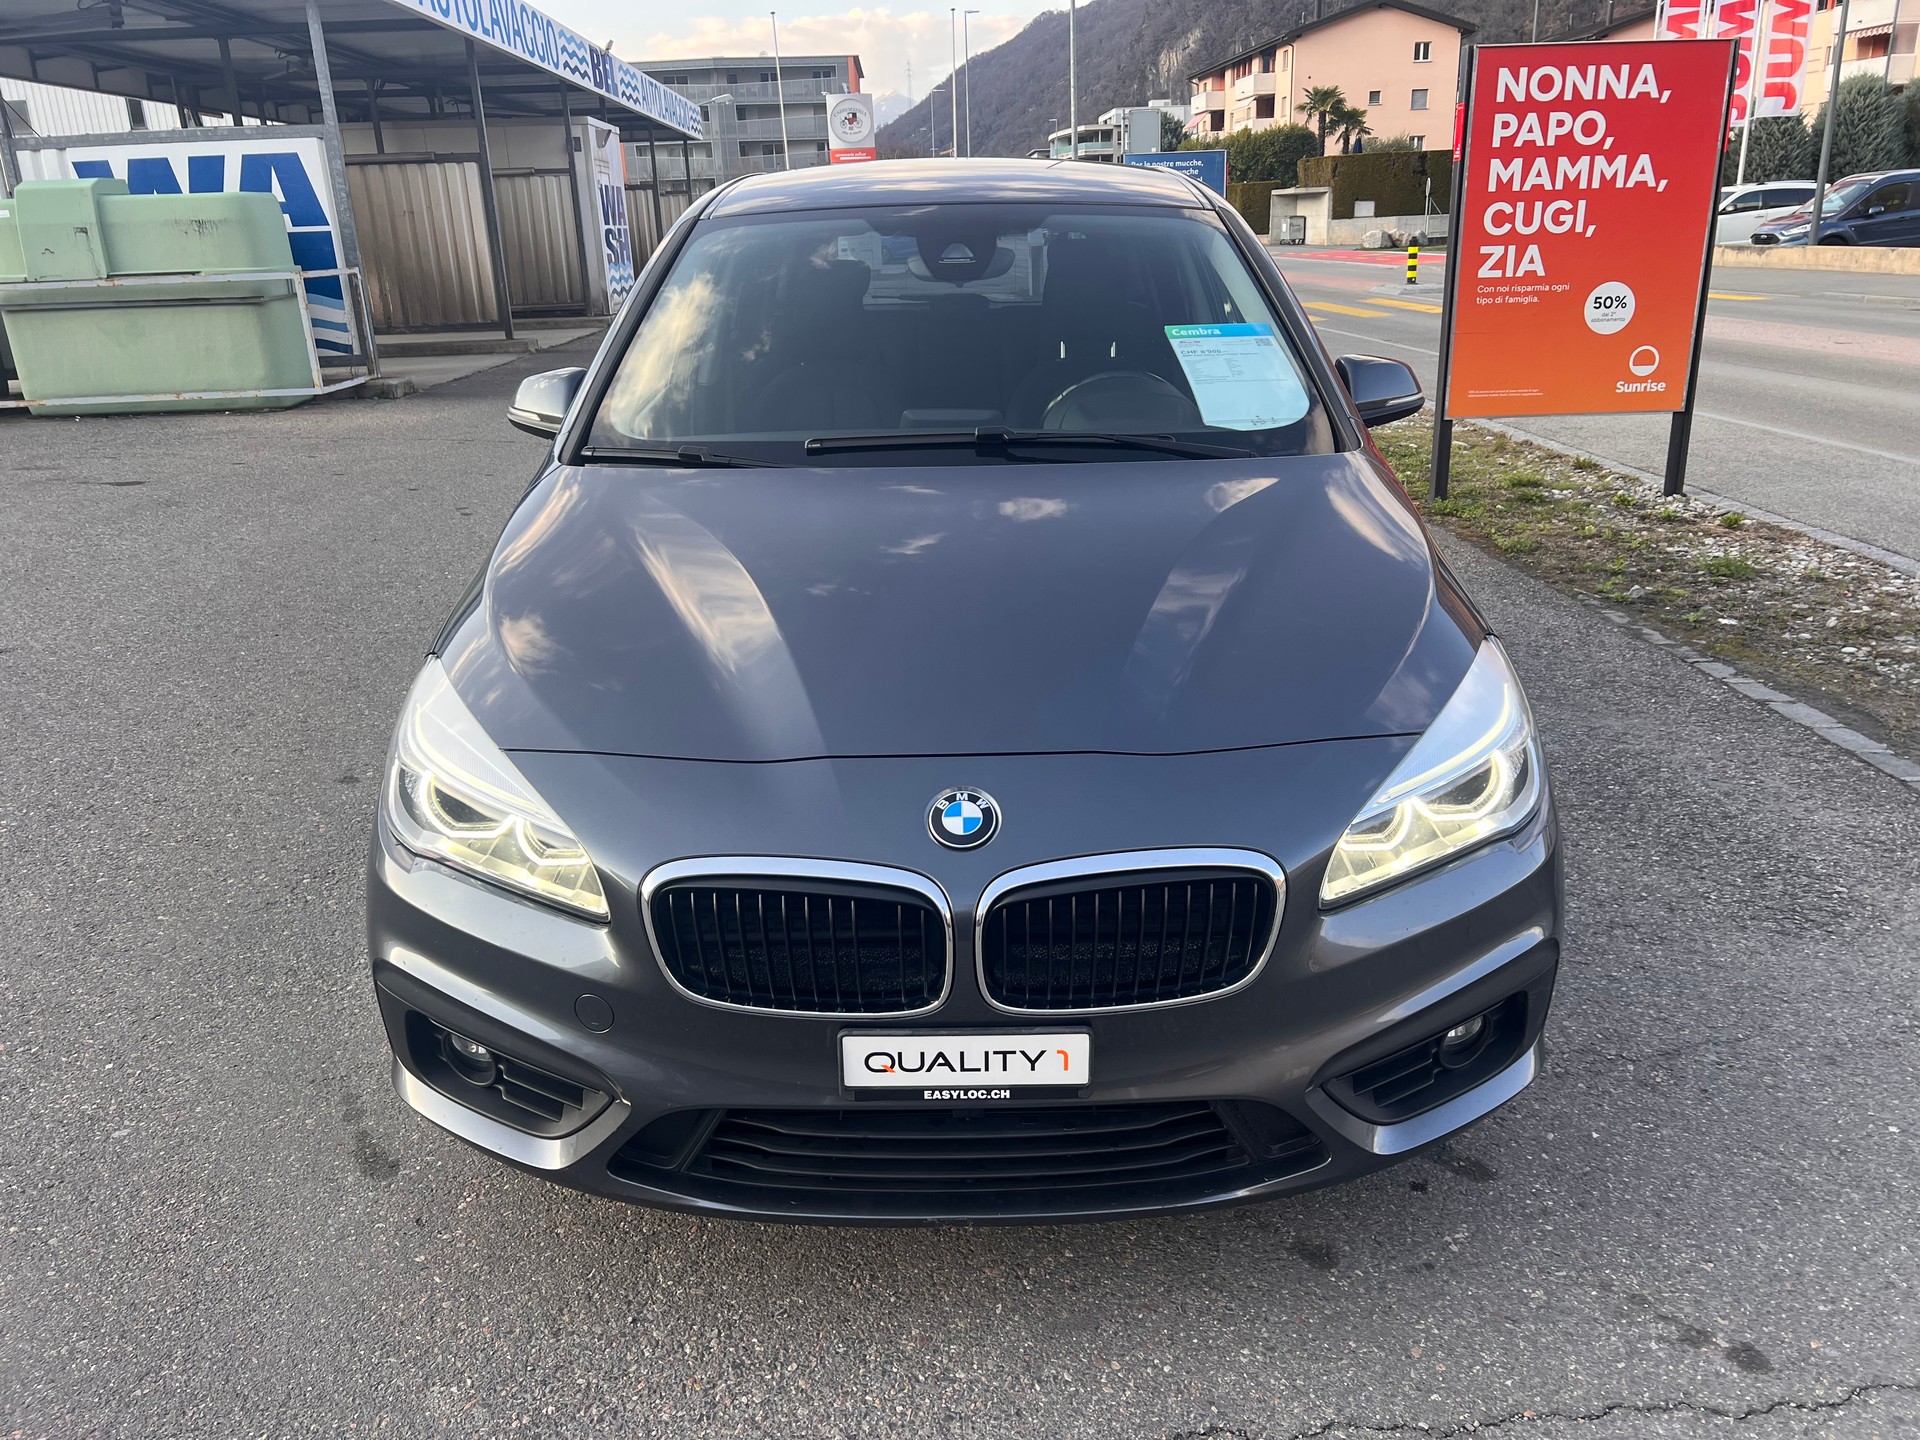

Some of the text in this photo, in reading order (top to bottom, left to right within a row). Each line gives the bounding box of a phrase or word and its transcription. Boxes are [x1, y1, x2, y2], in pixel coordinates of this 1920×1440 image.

[419, 0, 560, 70] OLAVACCIO
[588, 44, 620, 98] BEL
[1496, 63, 1672, 103] NONNA,
[1492, 110, 1615, 150] PAPO,
[1175, 159, 1204, 167] mucche,
[1487, 153, 1669, 193] MAMMA,
[1483, 200, 1597, 238] CUGI,
[1477, 244, 1546, 278] ZIA
[1477, 282, 1570, 293] Con noi risparmia ogni
[1476, 294, 1540, 305] tipo di famiglia.
[1593, 295, 1627, 309] 50%
[1171, 327, 1221, 336] Cembra
[1615, 380, 1667, 393] Sunrise
[936, 792, 990, 810] BMW
[864, 1049, 1069, 1073] QUALITY 1
[923, 1088, 1010, 1099] EASYLOC.CH
